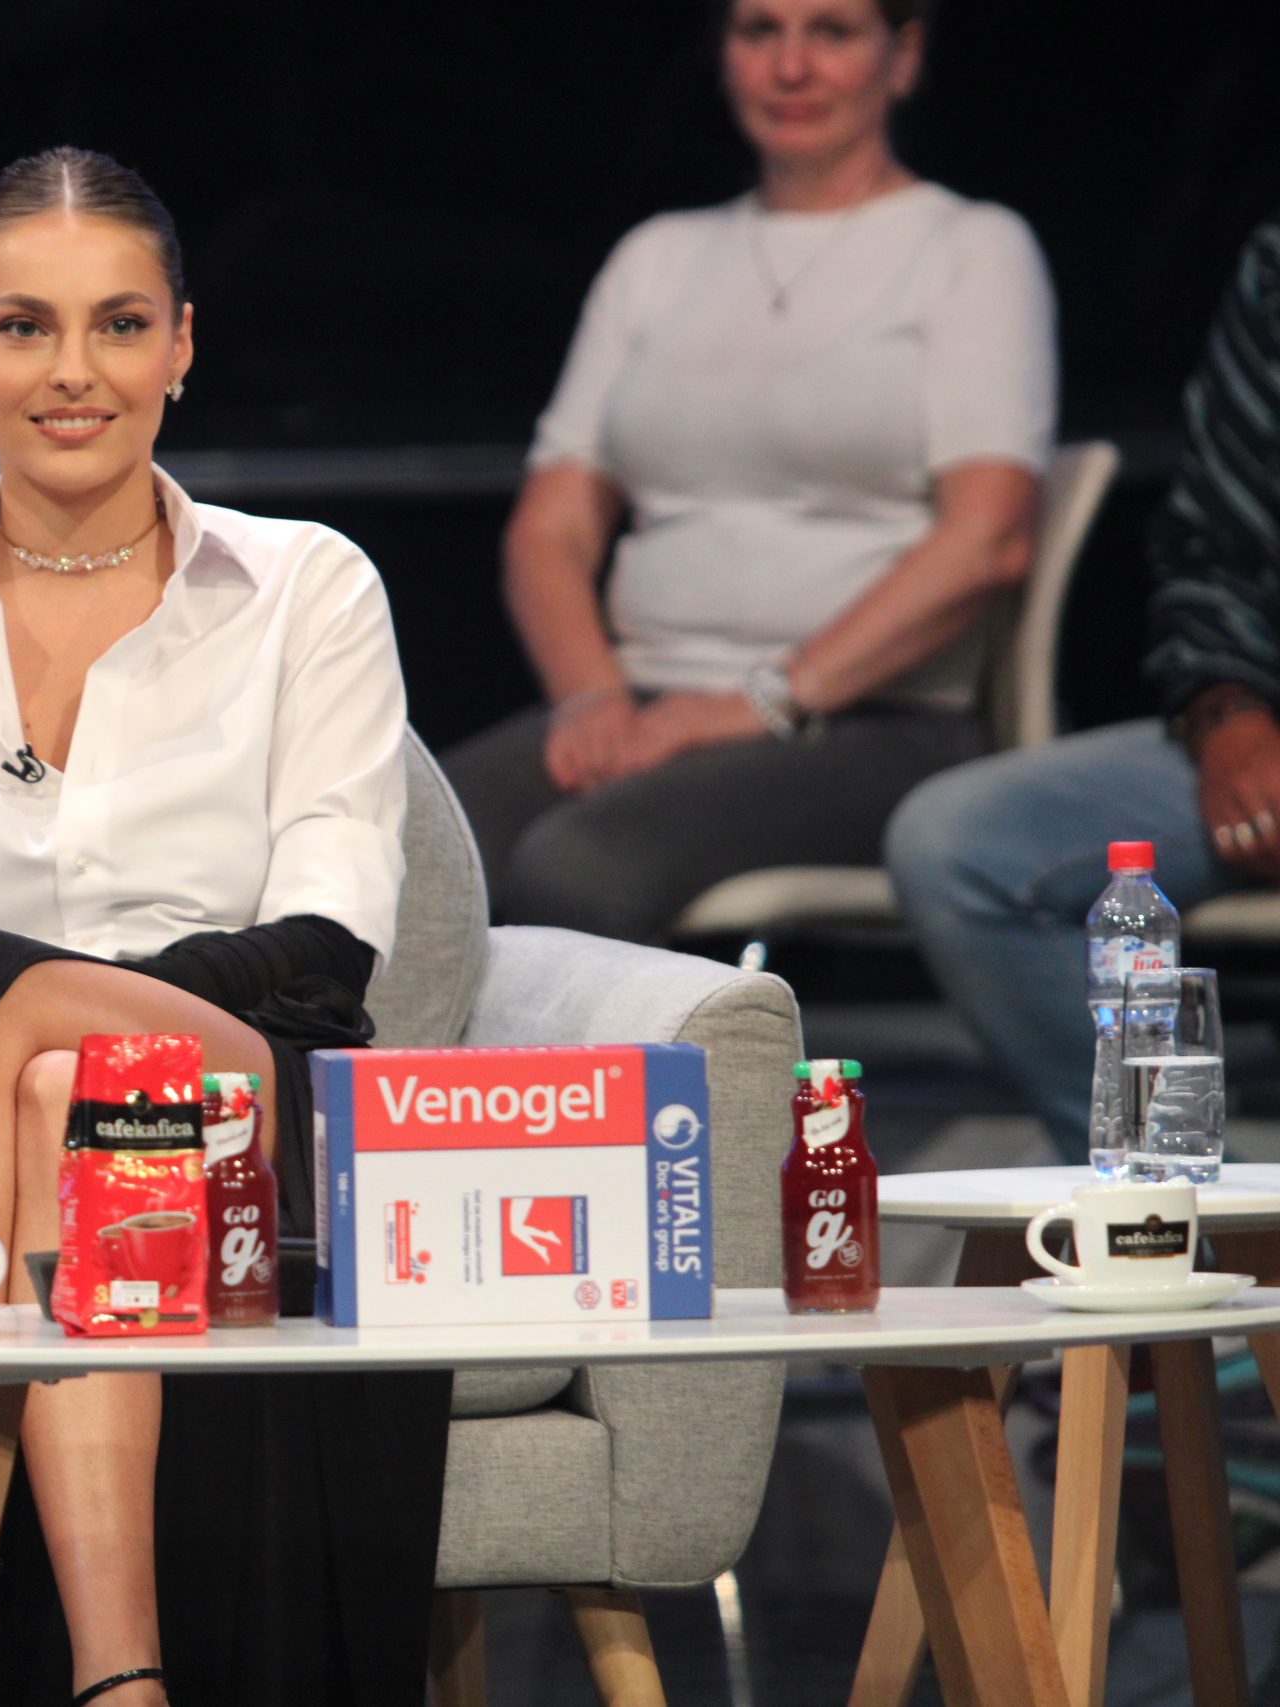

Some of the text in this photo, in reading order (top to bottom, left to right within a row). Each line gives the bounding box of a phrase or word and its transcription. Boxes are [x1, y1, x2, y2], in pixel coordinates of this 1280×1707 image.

[95, 1117, 196, 1139] cafekafica
[808, 1188, 847, 1208] GO
[222, 1204, 261, 1225] GO
[653, 1228, 669, 1272] group
